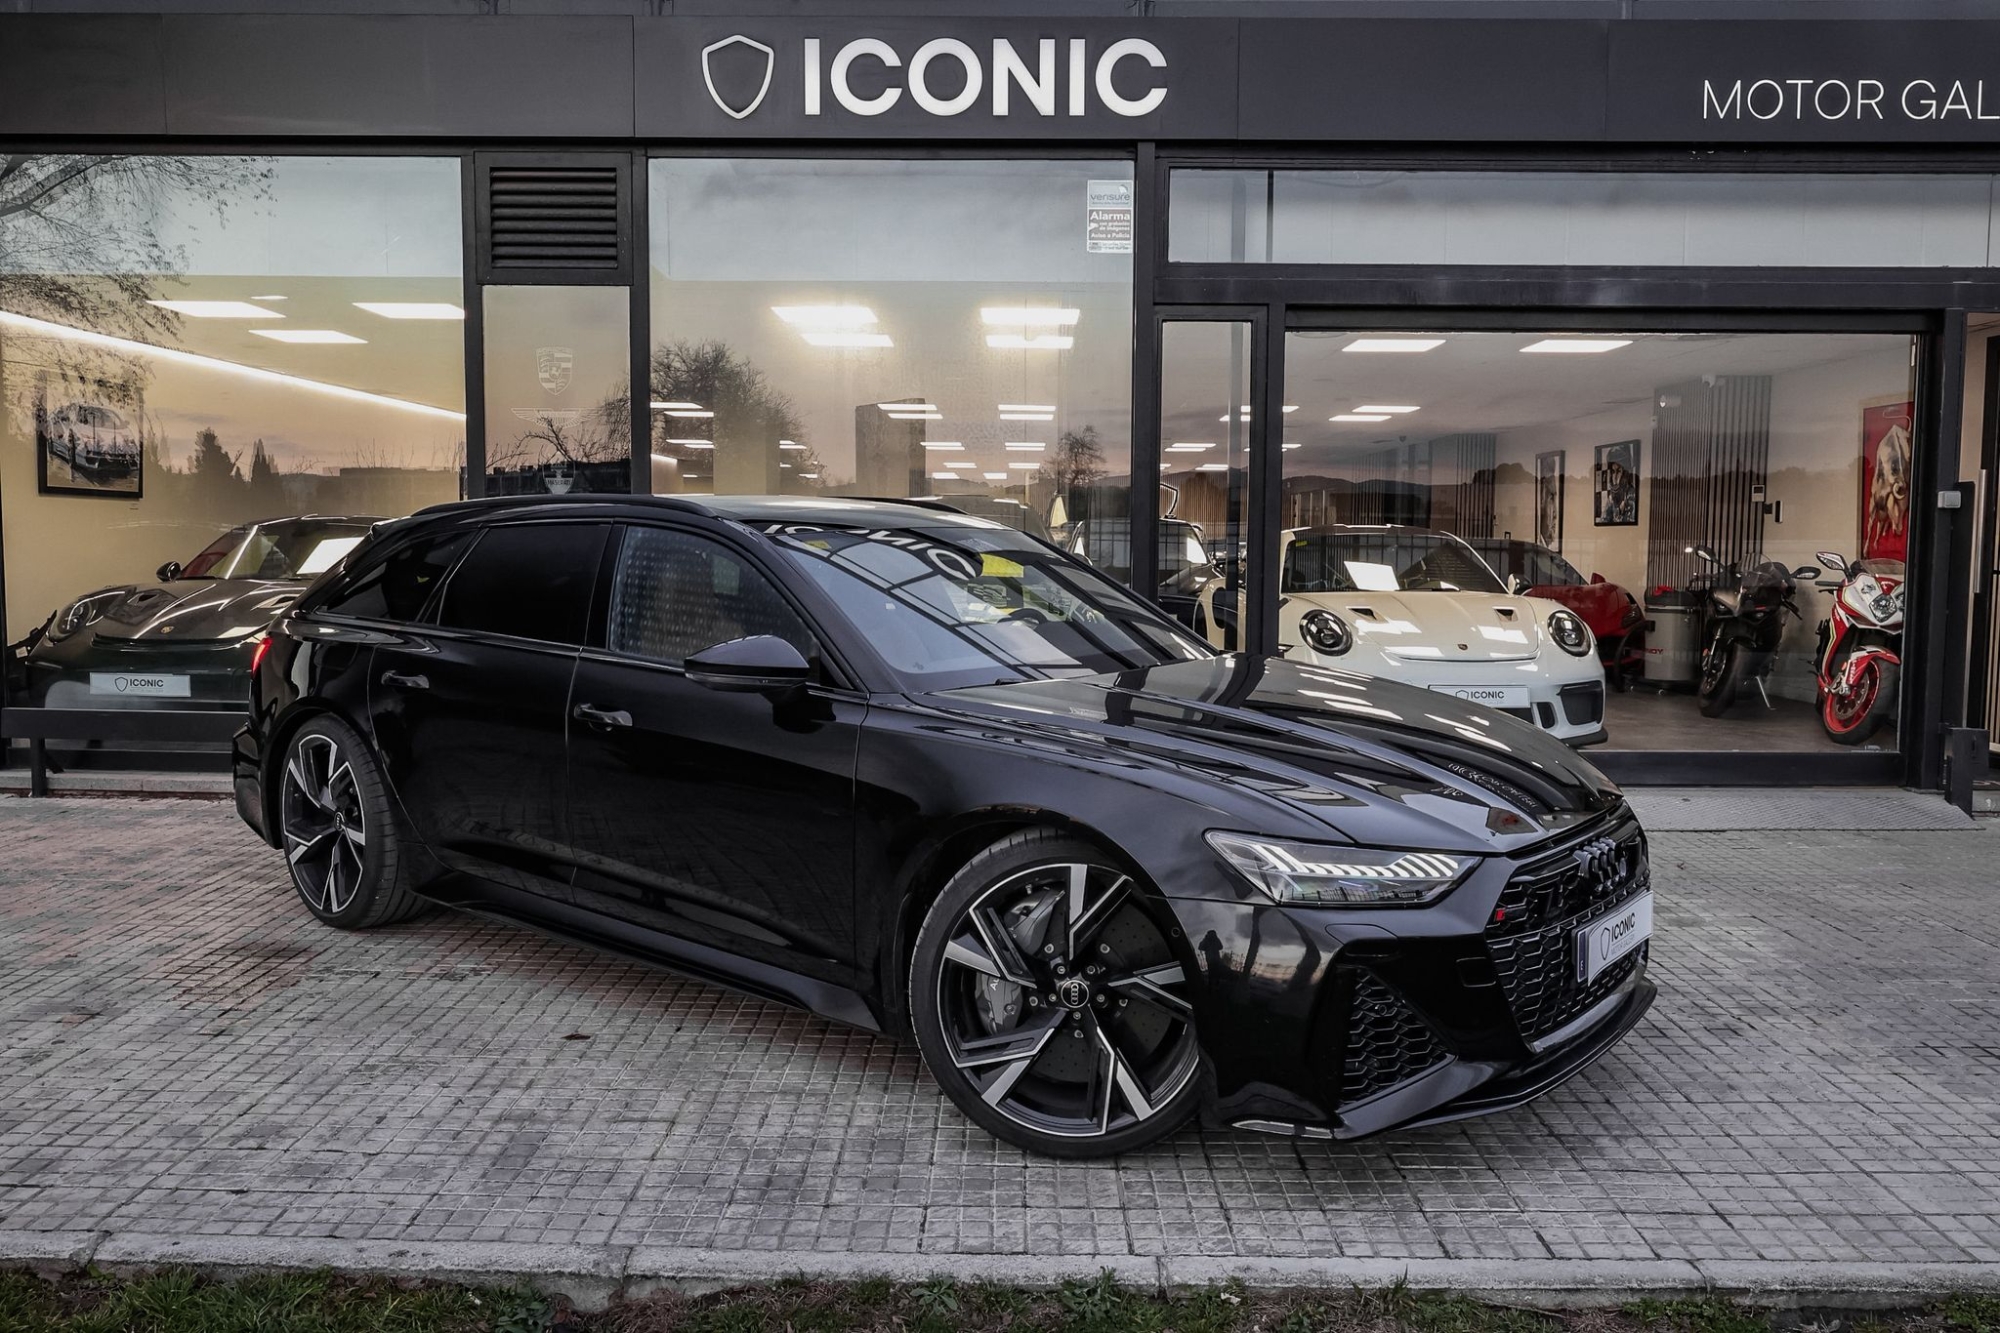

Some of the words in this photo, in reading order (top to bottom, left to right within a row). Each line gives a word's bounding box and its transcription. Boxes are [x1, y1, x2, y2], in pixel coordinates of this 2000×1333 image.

[805, 37, 1168, 117] ICONIC
[1703, 79, 1885, 120] MOTOR
[1090, 211, 1130, 221] Alarma
[129, 678, 164, 688] ICONIC
[1470, 691, 1504, 699] ICONIC
[1611, 912, 1636, 942] ICONIC
